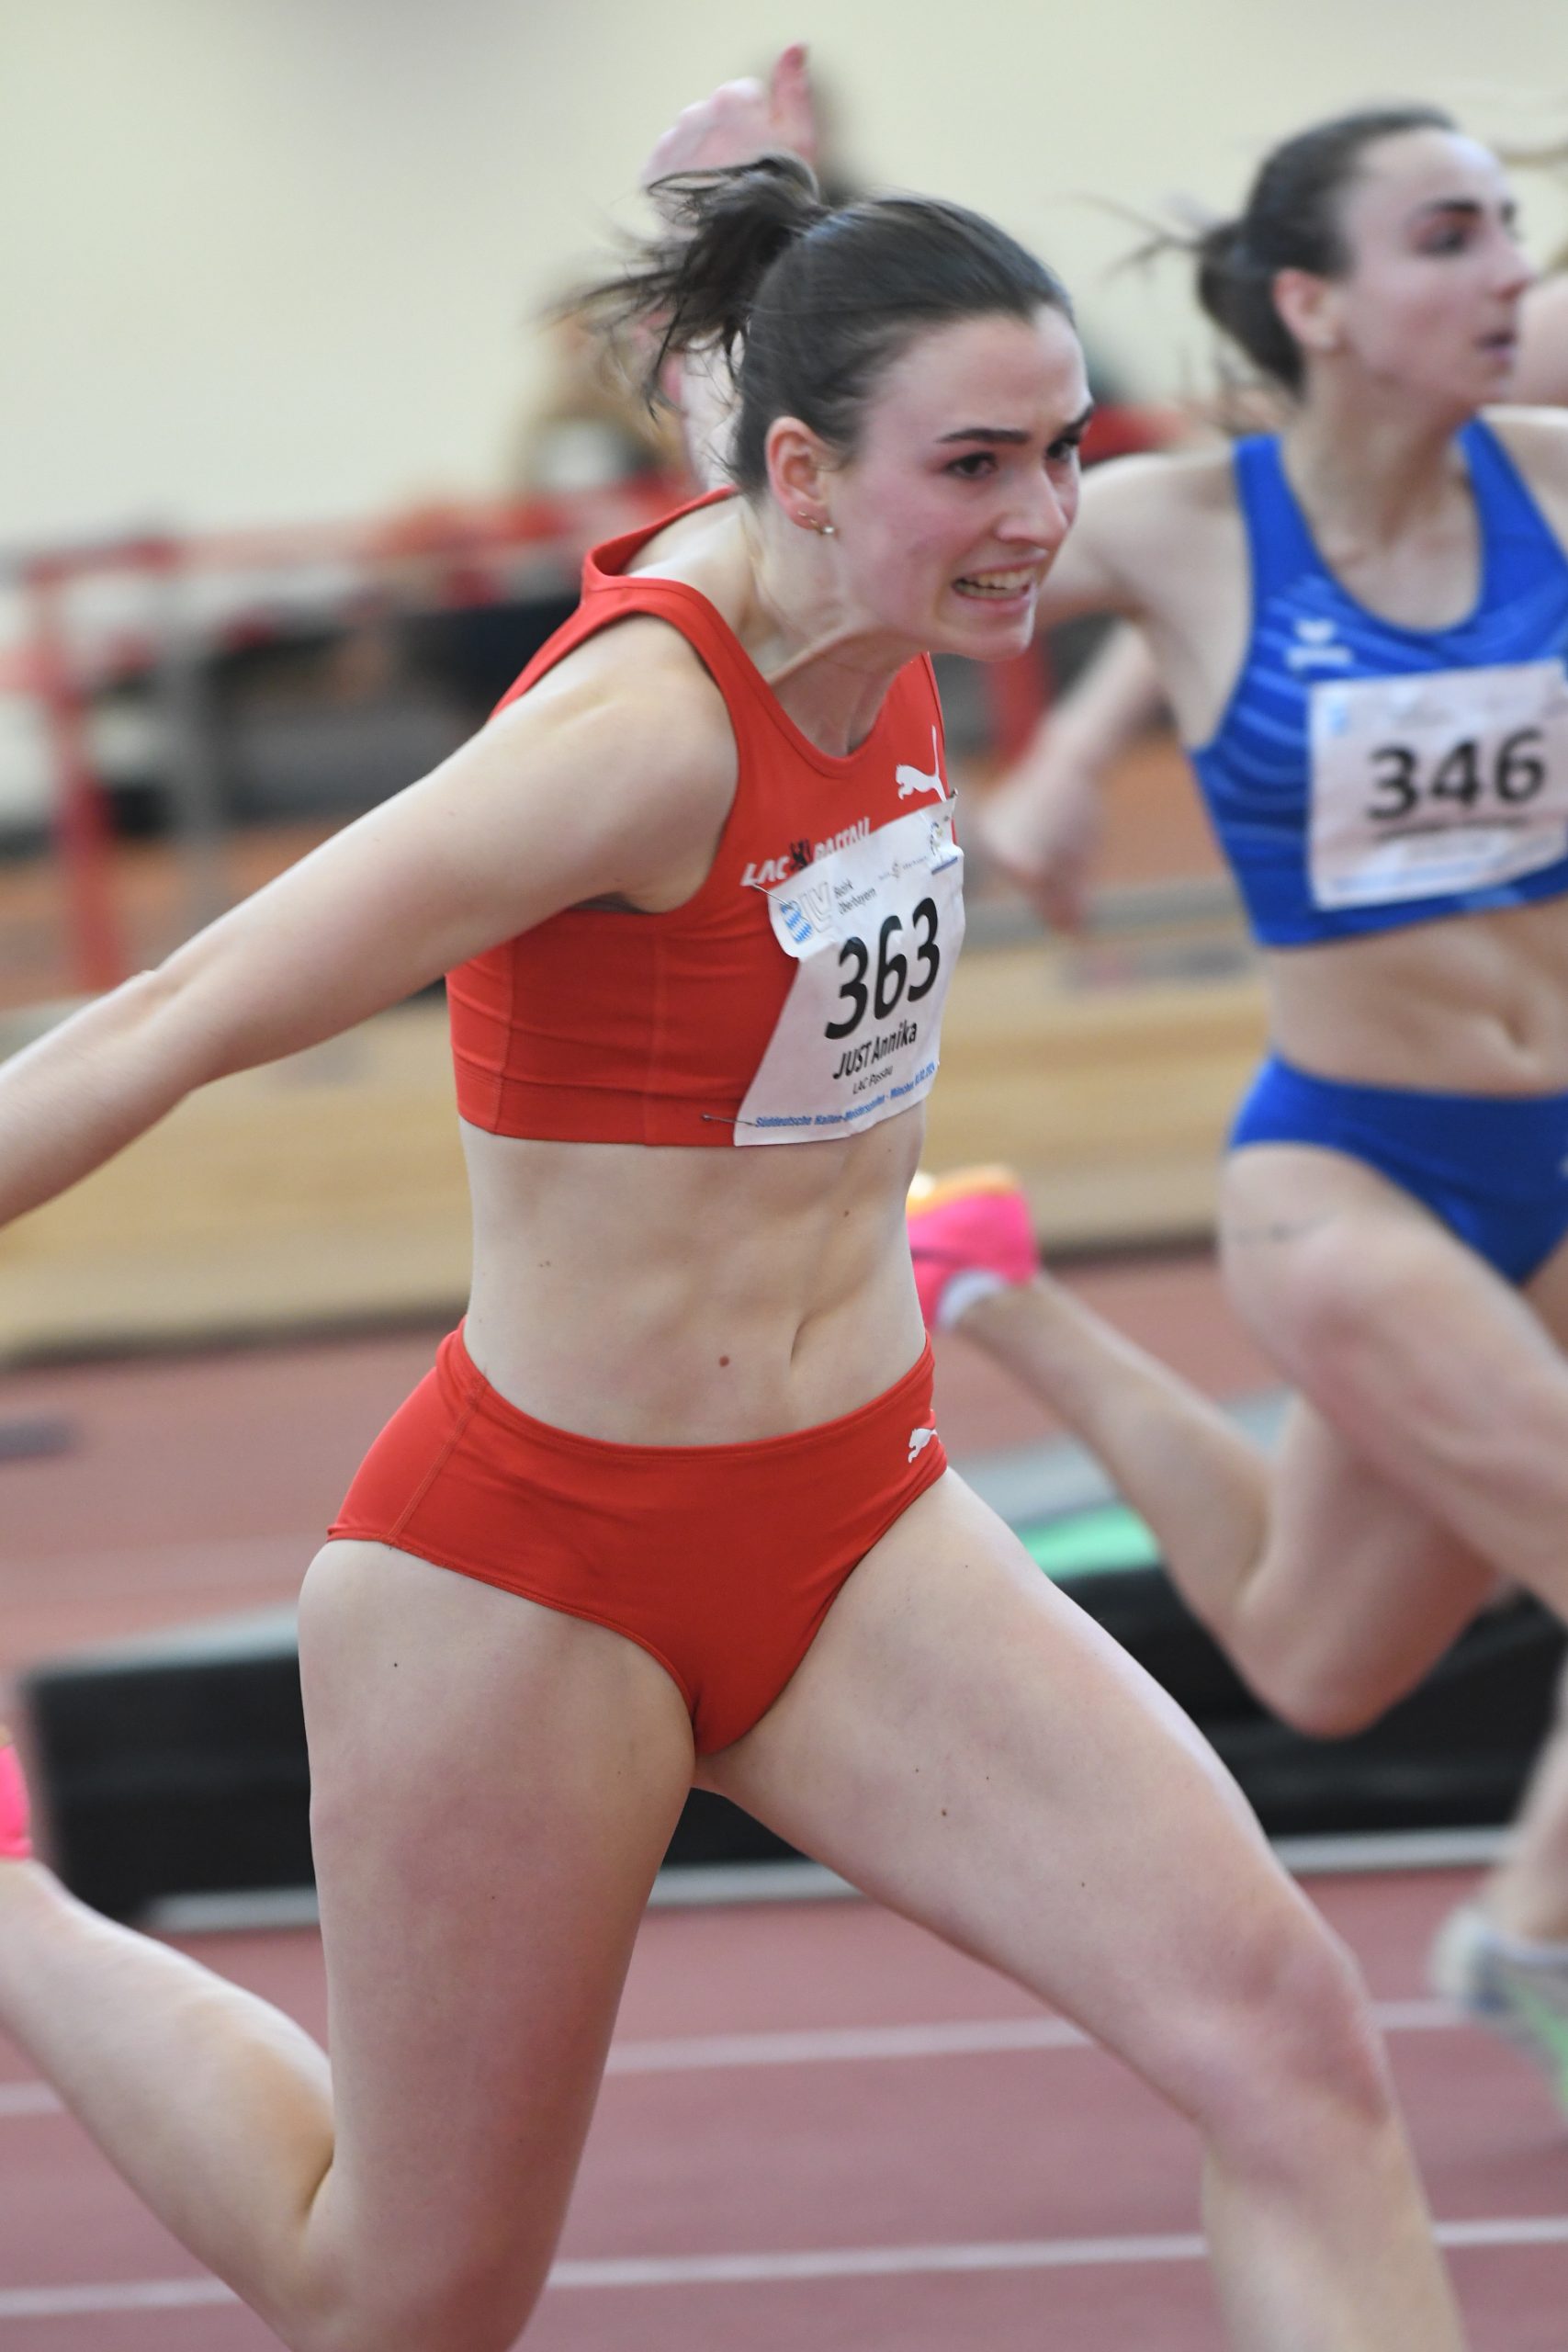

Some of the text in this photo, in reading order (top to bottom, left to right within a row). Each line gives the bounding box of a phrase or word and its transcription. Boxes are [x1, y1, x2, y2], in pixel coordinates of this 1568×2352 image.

[1368, 727, 1547, 821] 346
[740, 855, 790, 886] LAC
[825, 897, 941, 1039] 363
[832, 1040, 873, 1080] JUST
[871, 1019, 918, 1064] Annika
[756, 1116, 812, 1127] Süddeutsche
